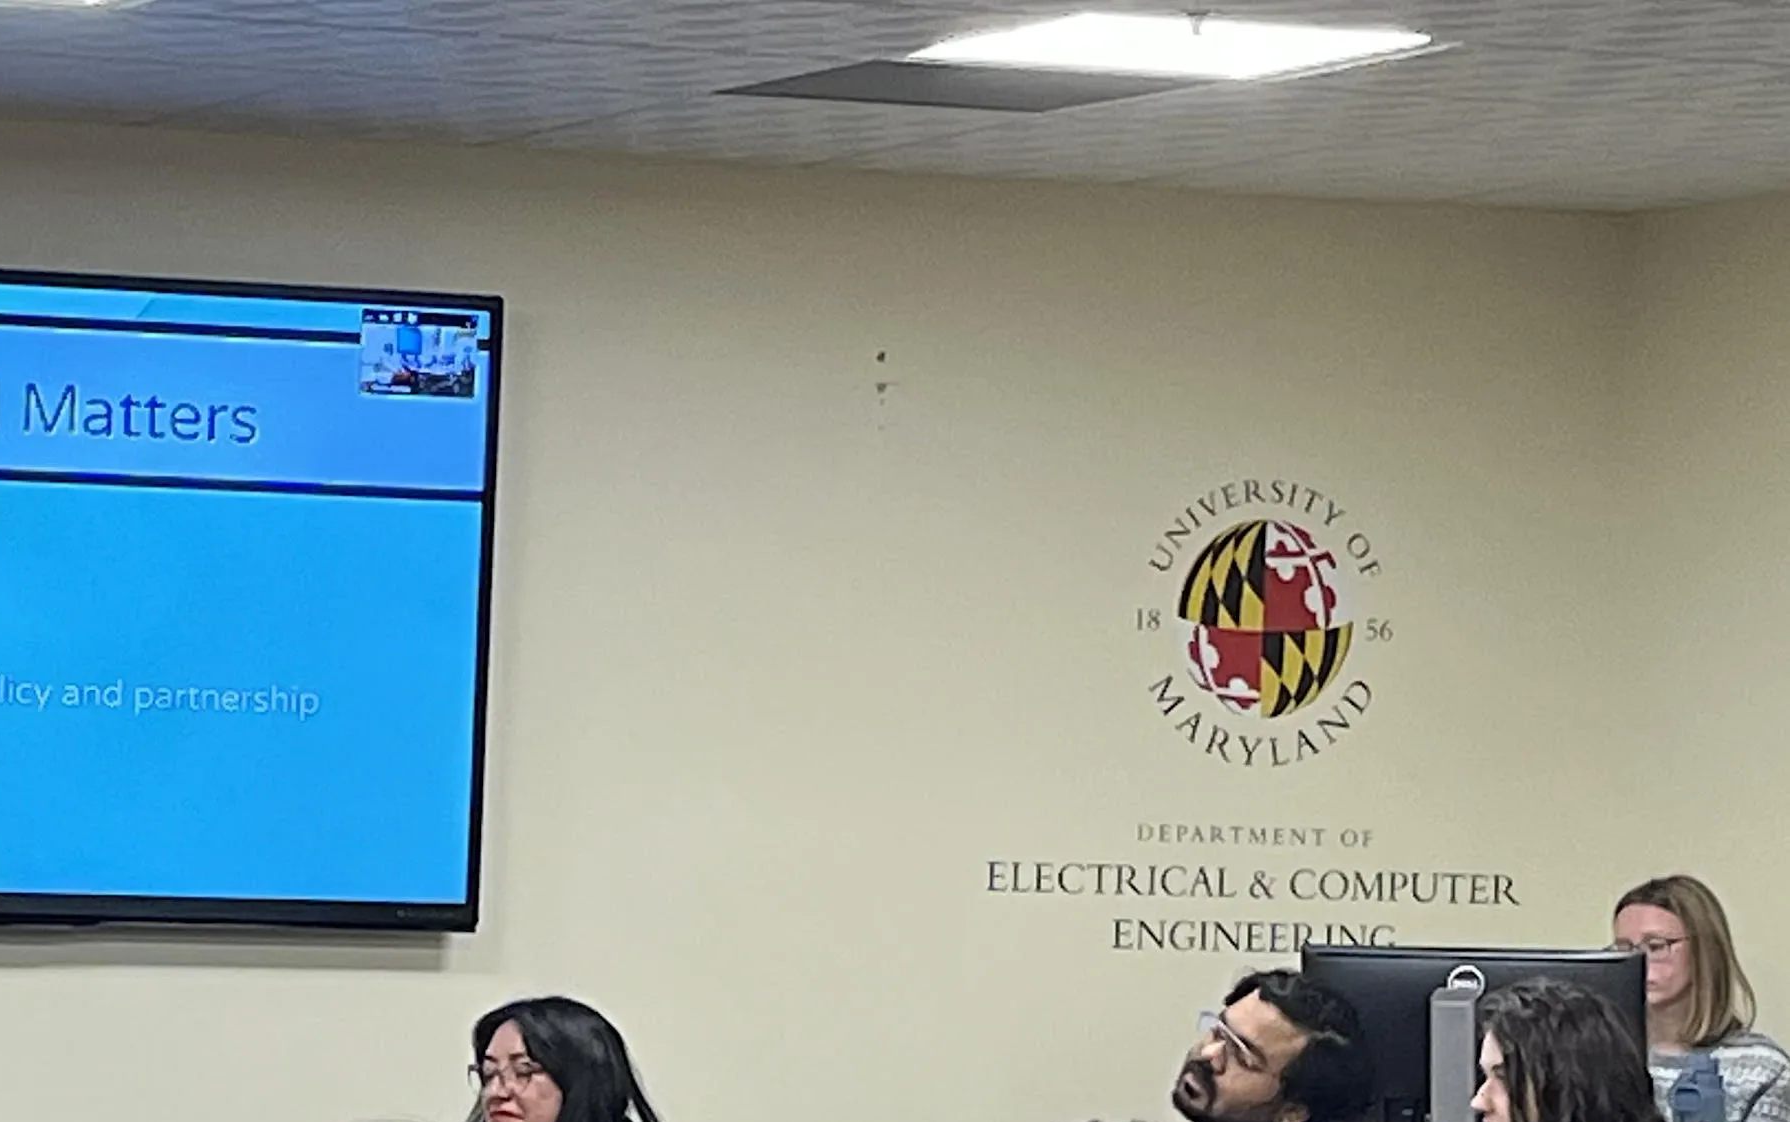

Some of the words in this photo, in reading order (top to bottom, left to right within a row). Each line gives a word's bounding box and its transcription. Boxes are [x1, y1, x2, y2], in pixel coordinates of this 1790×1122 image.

[22, 382, 258, 443] Matters
[1148, 479, 1347, 572] UNIVERSITY
[1346, 532, 1383, 583] OF
[1136, 608, 1162, 632] 18
[1365, 618, 1394, 642] 56
[60, 679, 123, 709] and
[133, 683, 321, 721] partnership
[1148, 674, 1373, 768] MARYLAND
[1136, 822, 1327, 847] DEPARTMENT
[1339, 828, 1375, 848] OF
[986, 861, 1238, 898] ELECTRICAL
[1248, 869, 1278, 900] &
[1288, 867, 1521, 906] COMPUTER
[1111, 918, 1397, 953] ENGINEERING
